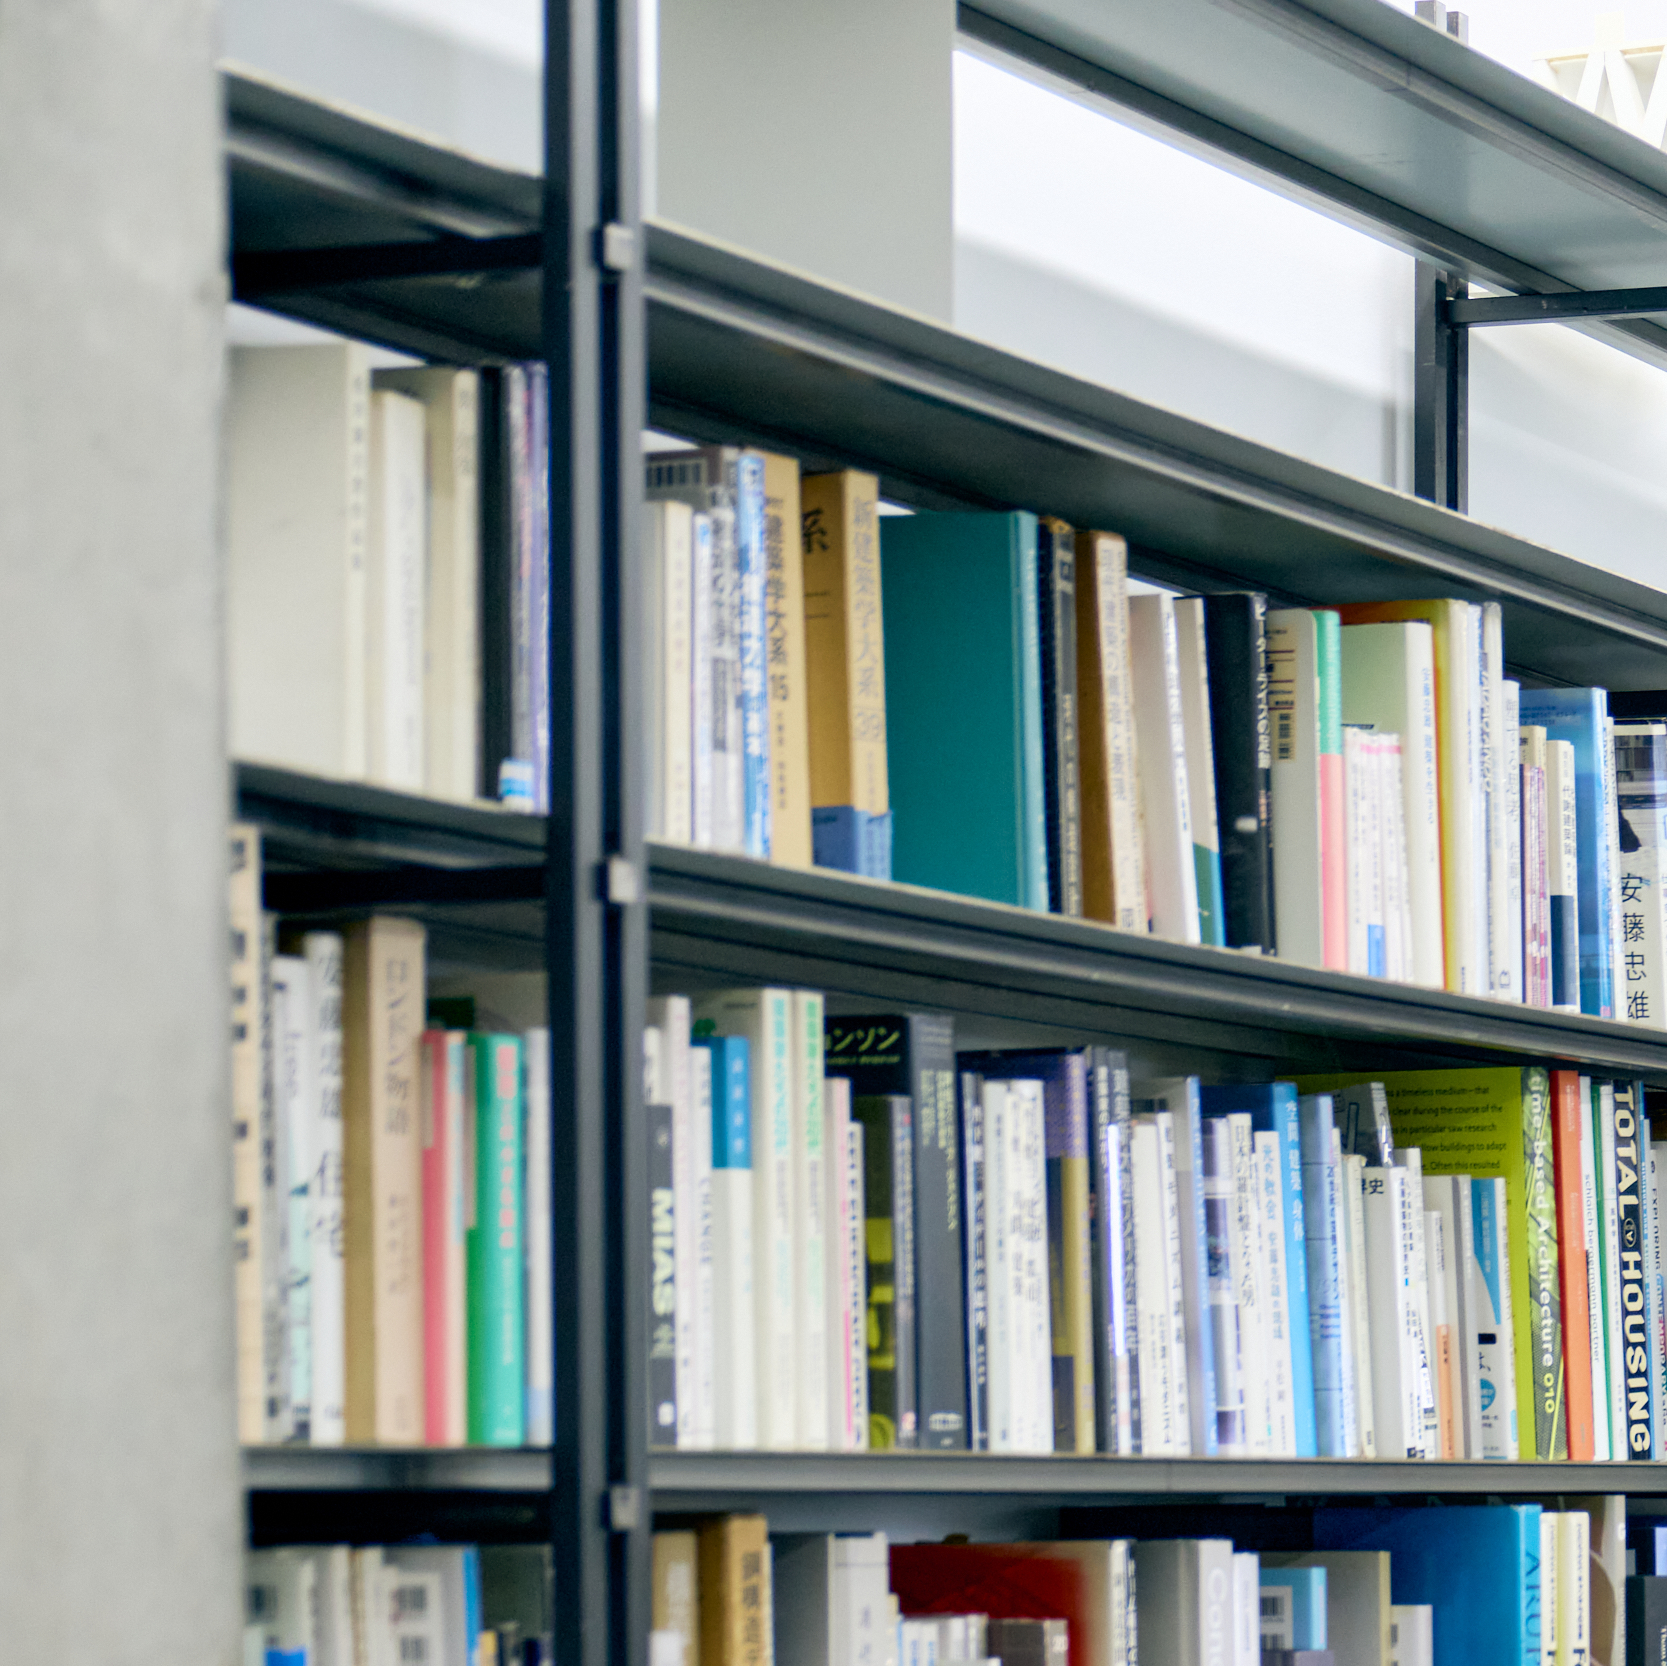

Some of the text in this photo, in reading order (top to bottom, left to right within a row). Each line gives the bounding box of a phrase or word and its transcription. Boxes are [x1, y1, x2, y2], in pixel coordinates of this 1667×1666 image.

[1621, 873, 1650, 1020] 安藤忠雄
[1527, 1073, 1554, 1414] time-based Architecture 010
[1585, 1174, 1600, 1362] schlaich bergermann partner
[1614, 1085, 1650, 1453] TOTAL HOUSING
